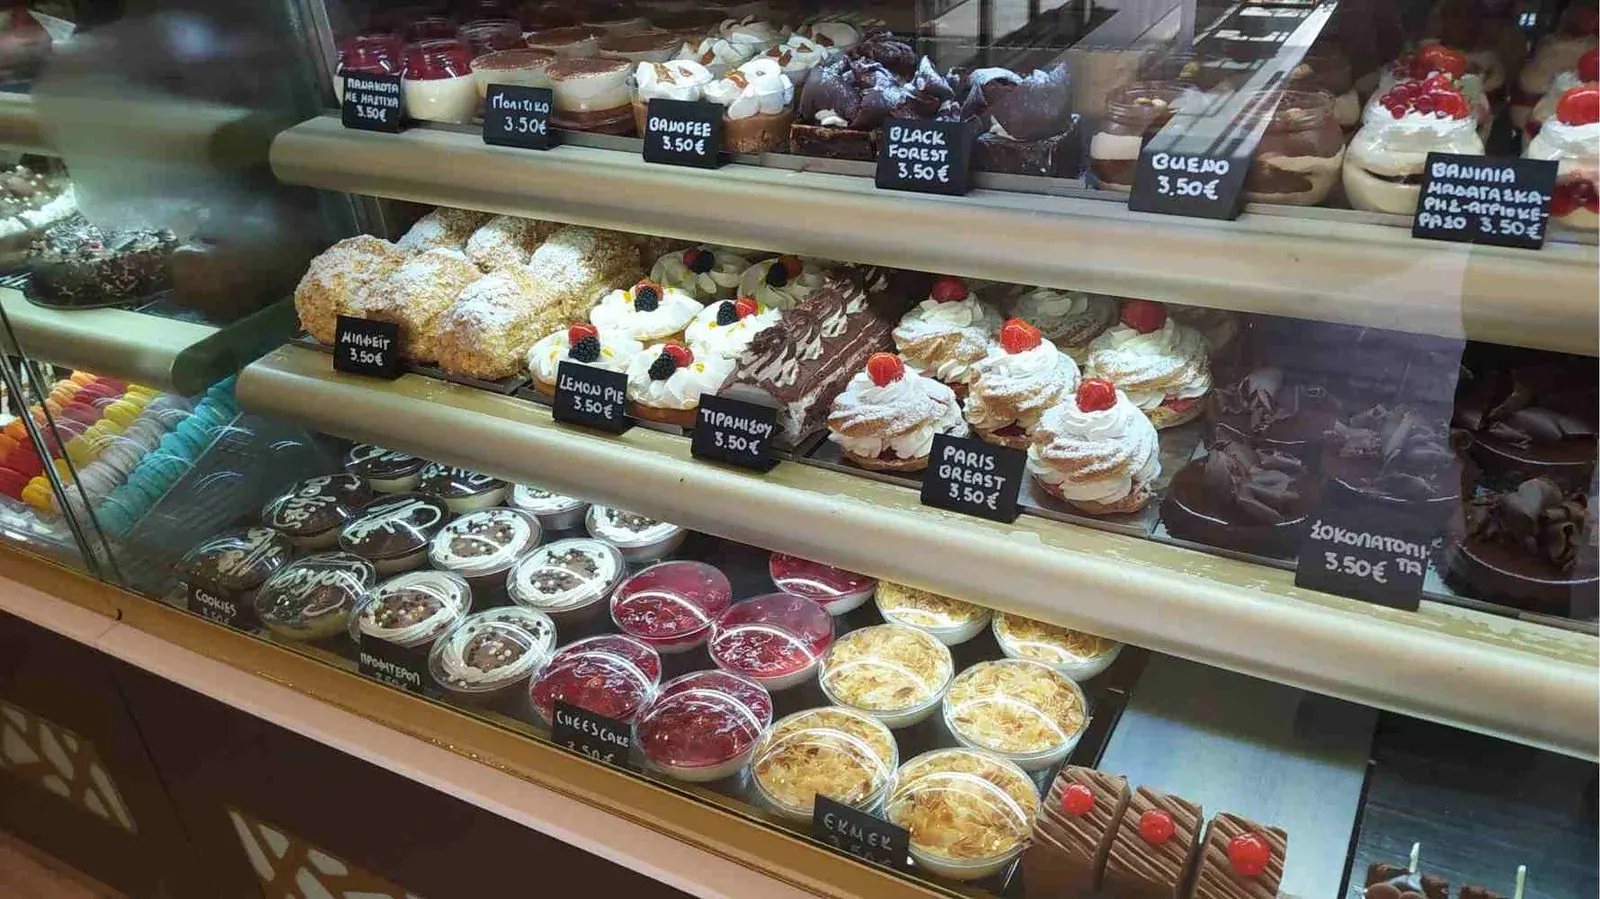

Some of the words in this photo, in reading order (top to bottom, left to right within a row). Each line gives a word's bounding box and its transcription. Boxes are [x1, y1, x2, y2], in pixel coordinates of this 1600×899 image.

[360, 94, 399, 108] ΜΑΣΤΙΧΑ
[356, 105, 387, 123] 3.50€
[504, 116, 547, 136] 3.50€
[649, 116, 712, 138] BANOFEE
[889, 126, 946, 146] BLACK
[662, 135, 706, 156] 3.50€
[888, 144, 949, 162] FOREST
[898, 162, 950, 183] 3.50€
[1152, 152, 1230, 175] BUENO
[1157, 175, 1220, 201] 3.50€
[1479, 216, 1542, 240] 3.50€
[350, 347, 383, 367] 3.50€
[559, 374, 601, 397] LEMON
[604, 386, 625, 405] PIE
[573, 395, 614, 420] 3.50€
[700, 407, 773, 440] ΤΙΡΑΜΙΣΟΥ
[714, 431, 760, 456] 3.50€
[943, 445, 996, 471] PARIS
[939, 464, 1006, 490] BREAST
[948, 482, 1000, 511] 3.50€
[1323, 551, 1389, 584] 3.50€
[1396, 557, 1422, 576] ΤΑ
[195, 588, 237, 617] COOKIES
[556, 710, 630, 748] CHEESCAKE
